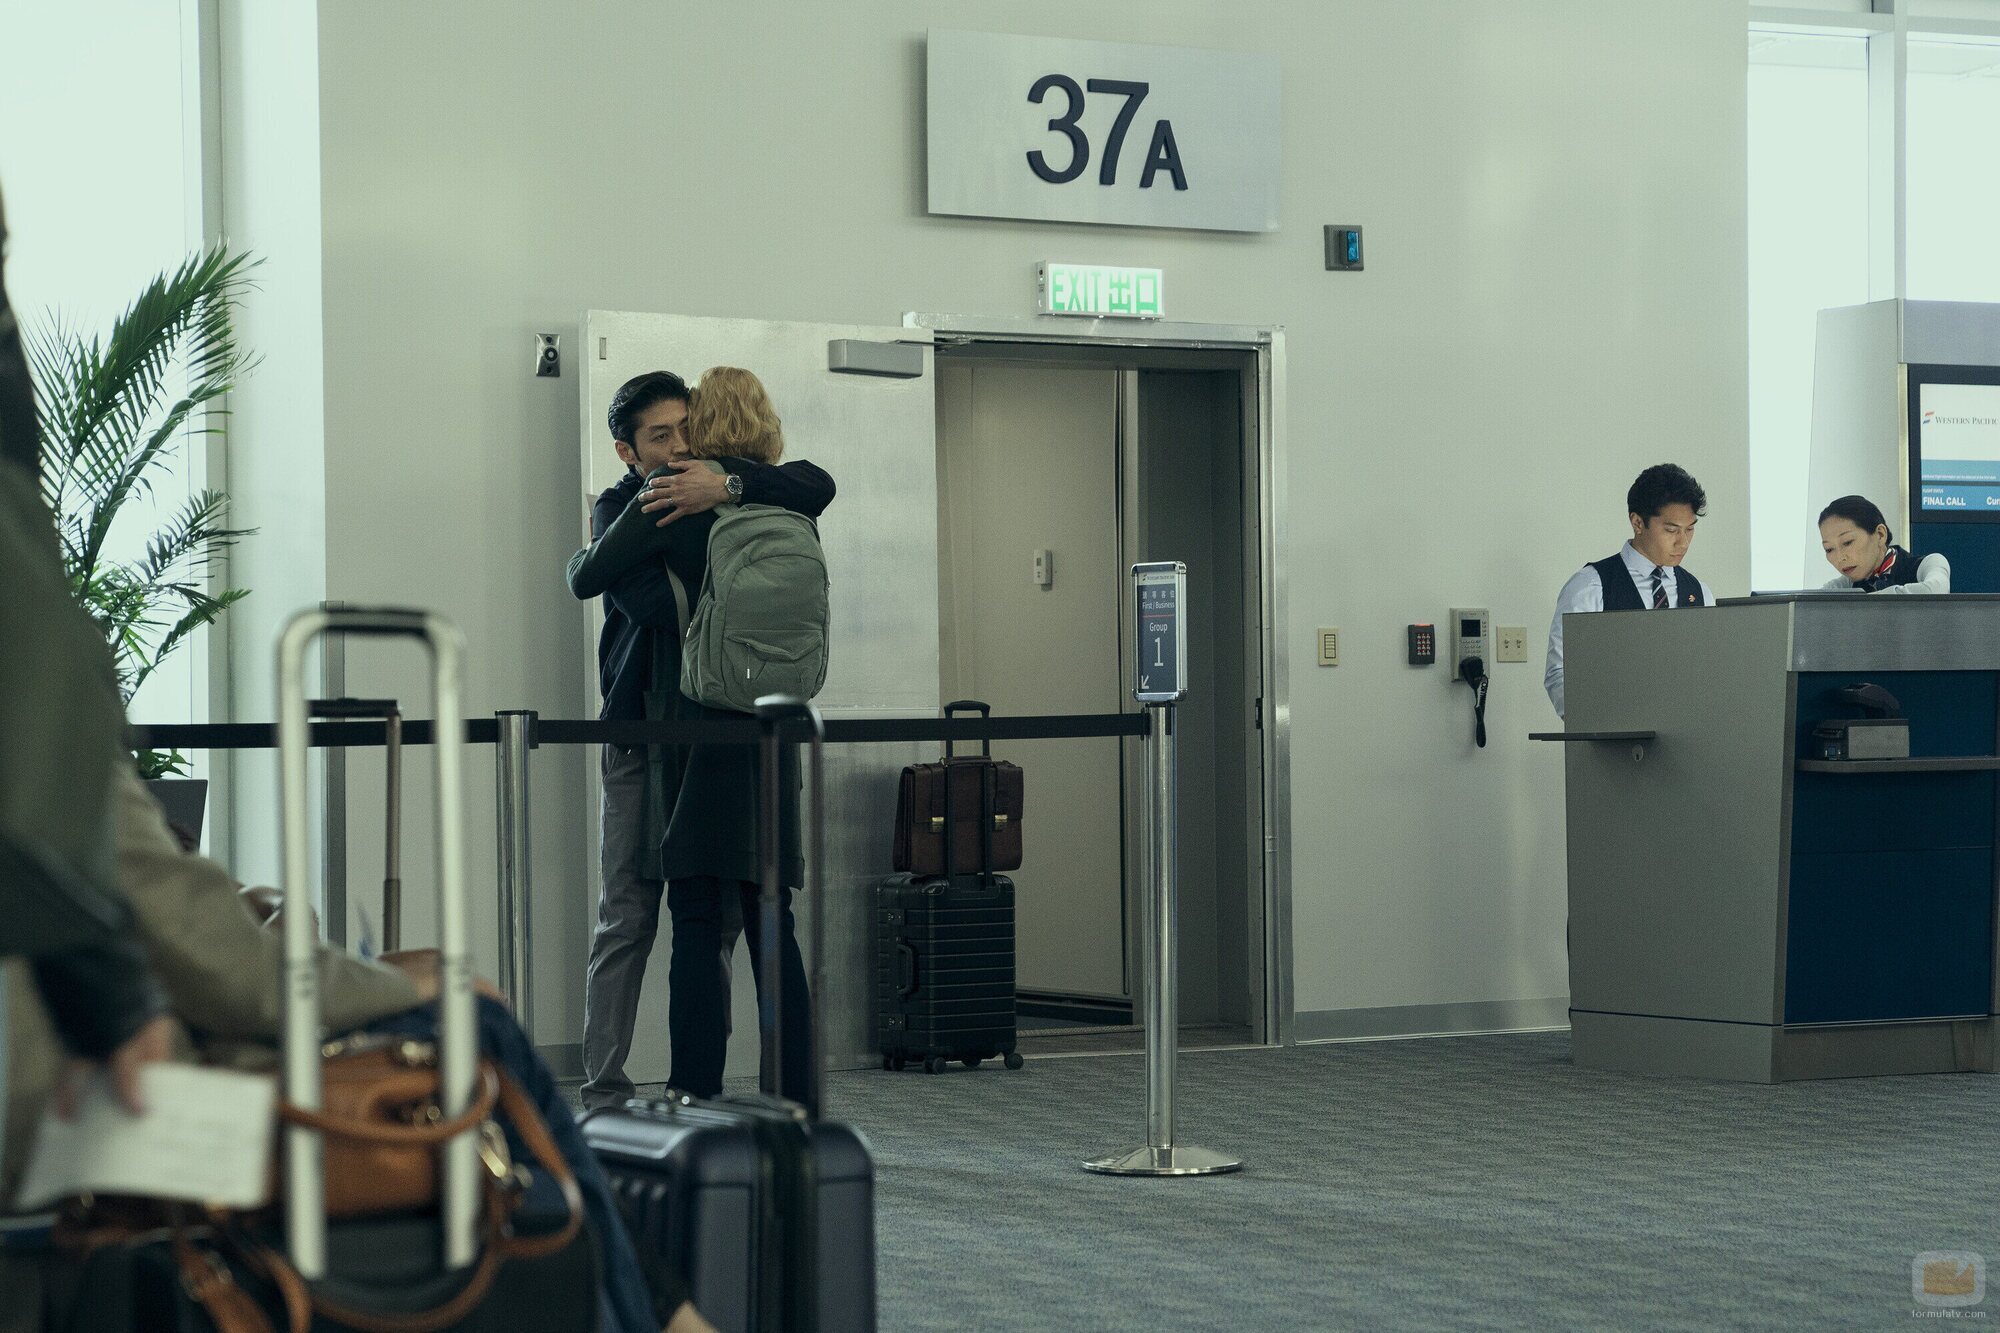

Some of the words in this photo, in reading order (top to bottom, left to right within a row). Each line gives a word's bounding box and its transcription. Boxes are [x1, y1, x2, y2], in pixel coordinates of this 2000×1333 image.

[1026, 74, 1188, 190] 37A
[1052, 268, 1101, 312] EXIT
[1109, 271, 1158, 314] 出口
[1935, 416, 1971, 424] WESTERN
[1923, 496, 1945, 506] FINAL
[1946, 496, 1967, 506] CALL
[1149, 622, 1168, 634] Group
[1154, 637, 1164, 667] 1
